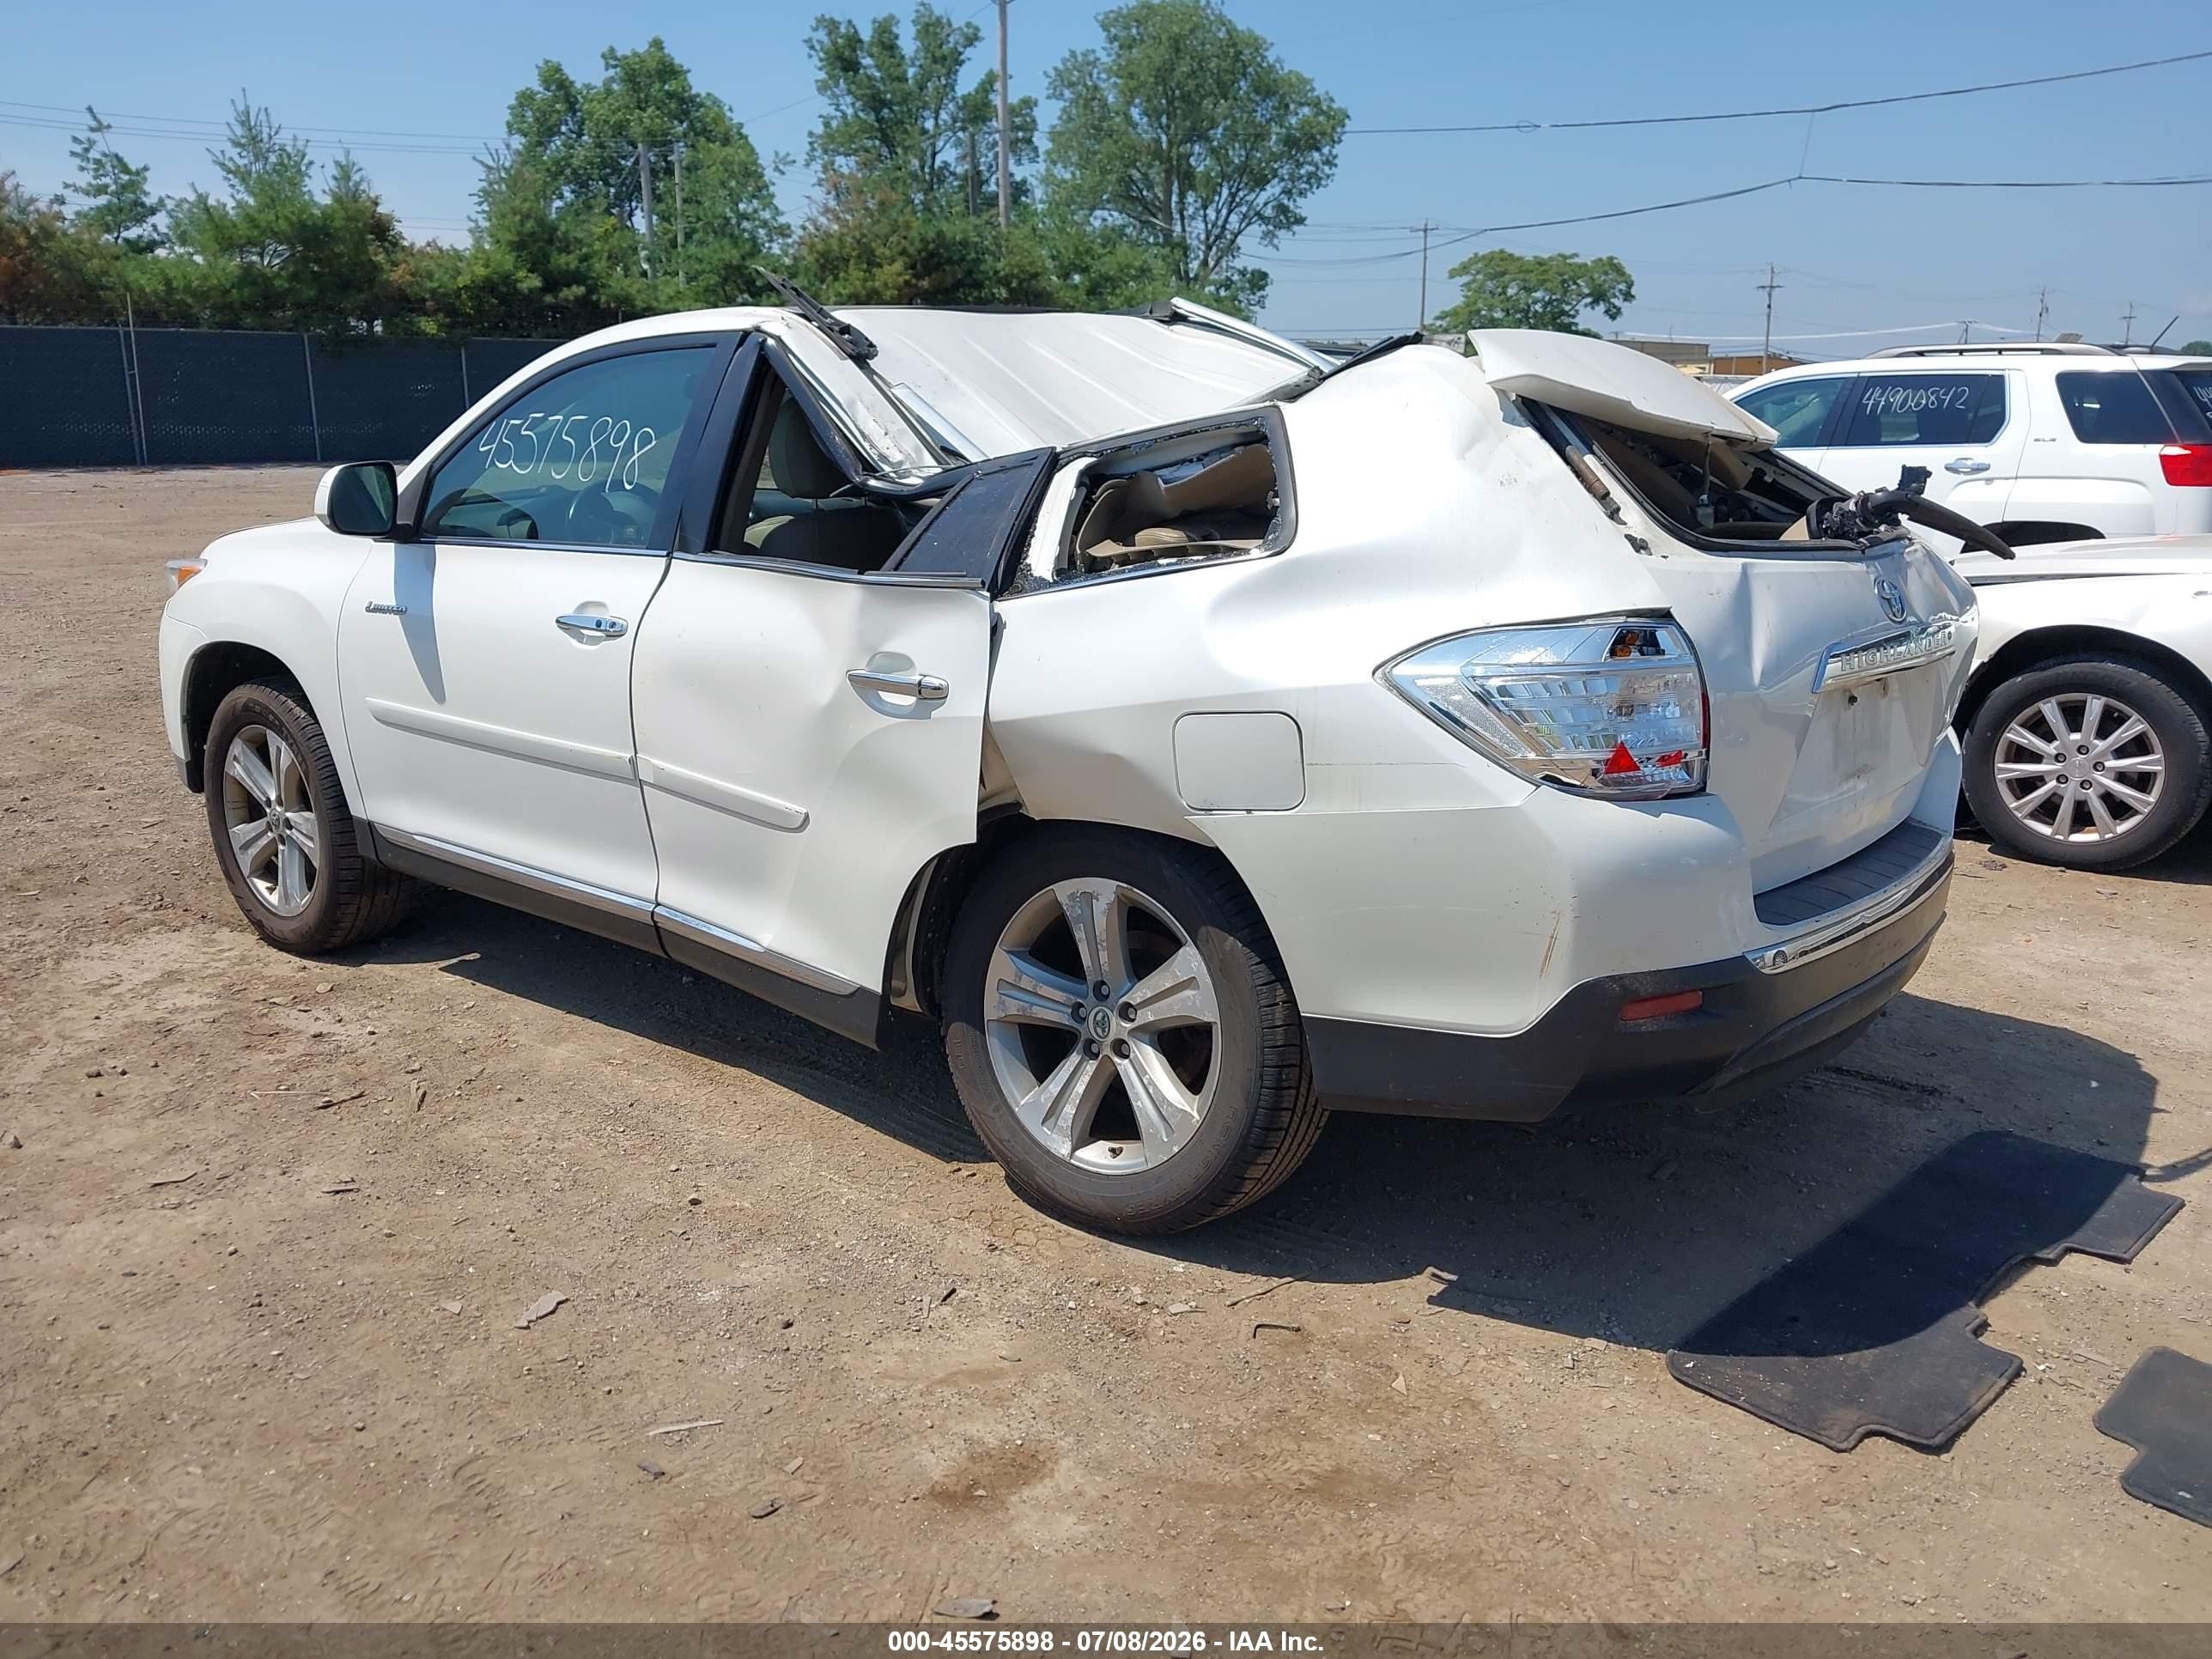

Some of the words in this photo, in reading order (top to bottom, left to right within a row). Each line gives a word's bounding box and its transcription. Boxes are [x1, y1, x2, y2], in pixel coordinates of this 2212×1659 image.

[1862, 386, 1970, 415] 44900842
[478, 412, 658, 493] 45575898
[1840, 631, 1948, 672] HIGHLANDER
